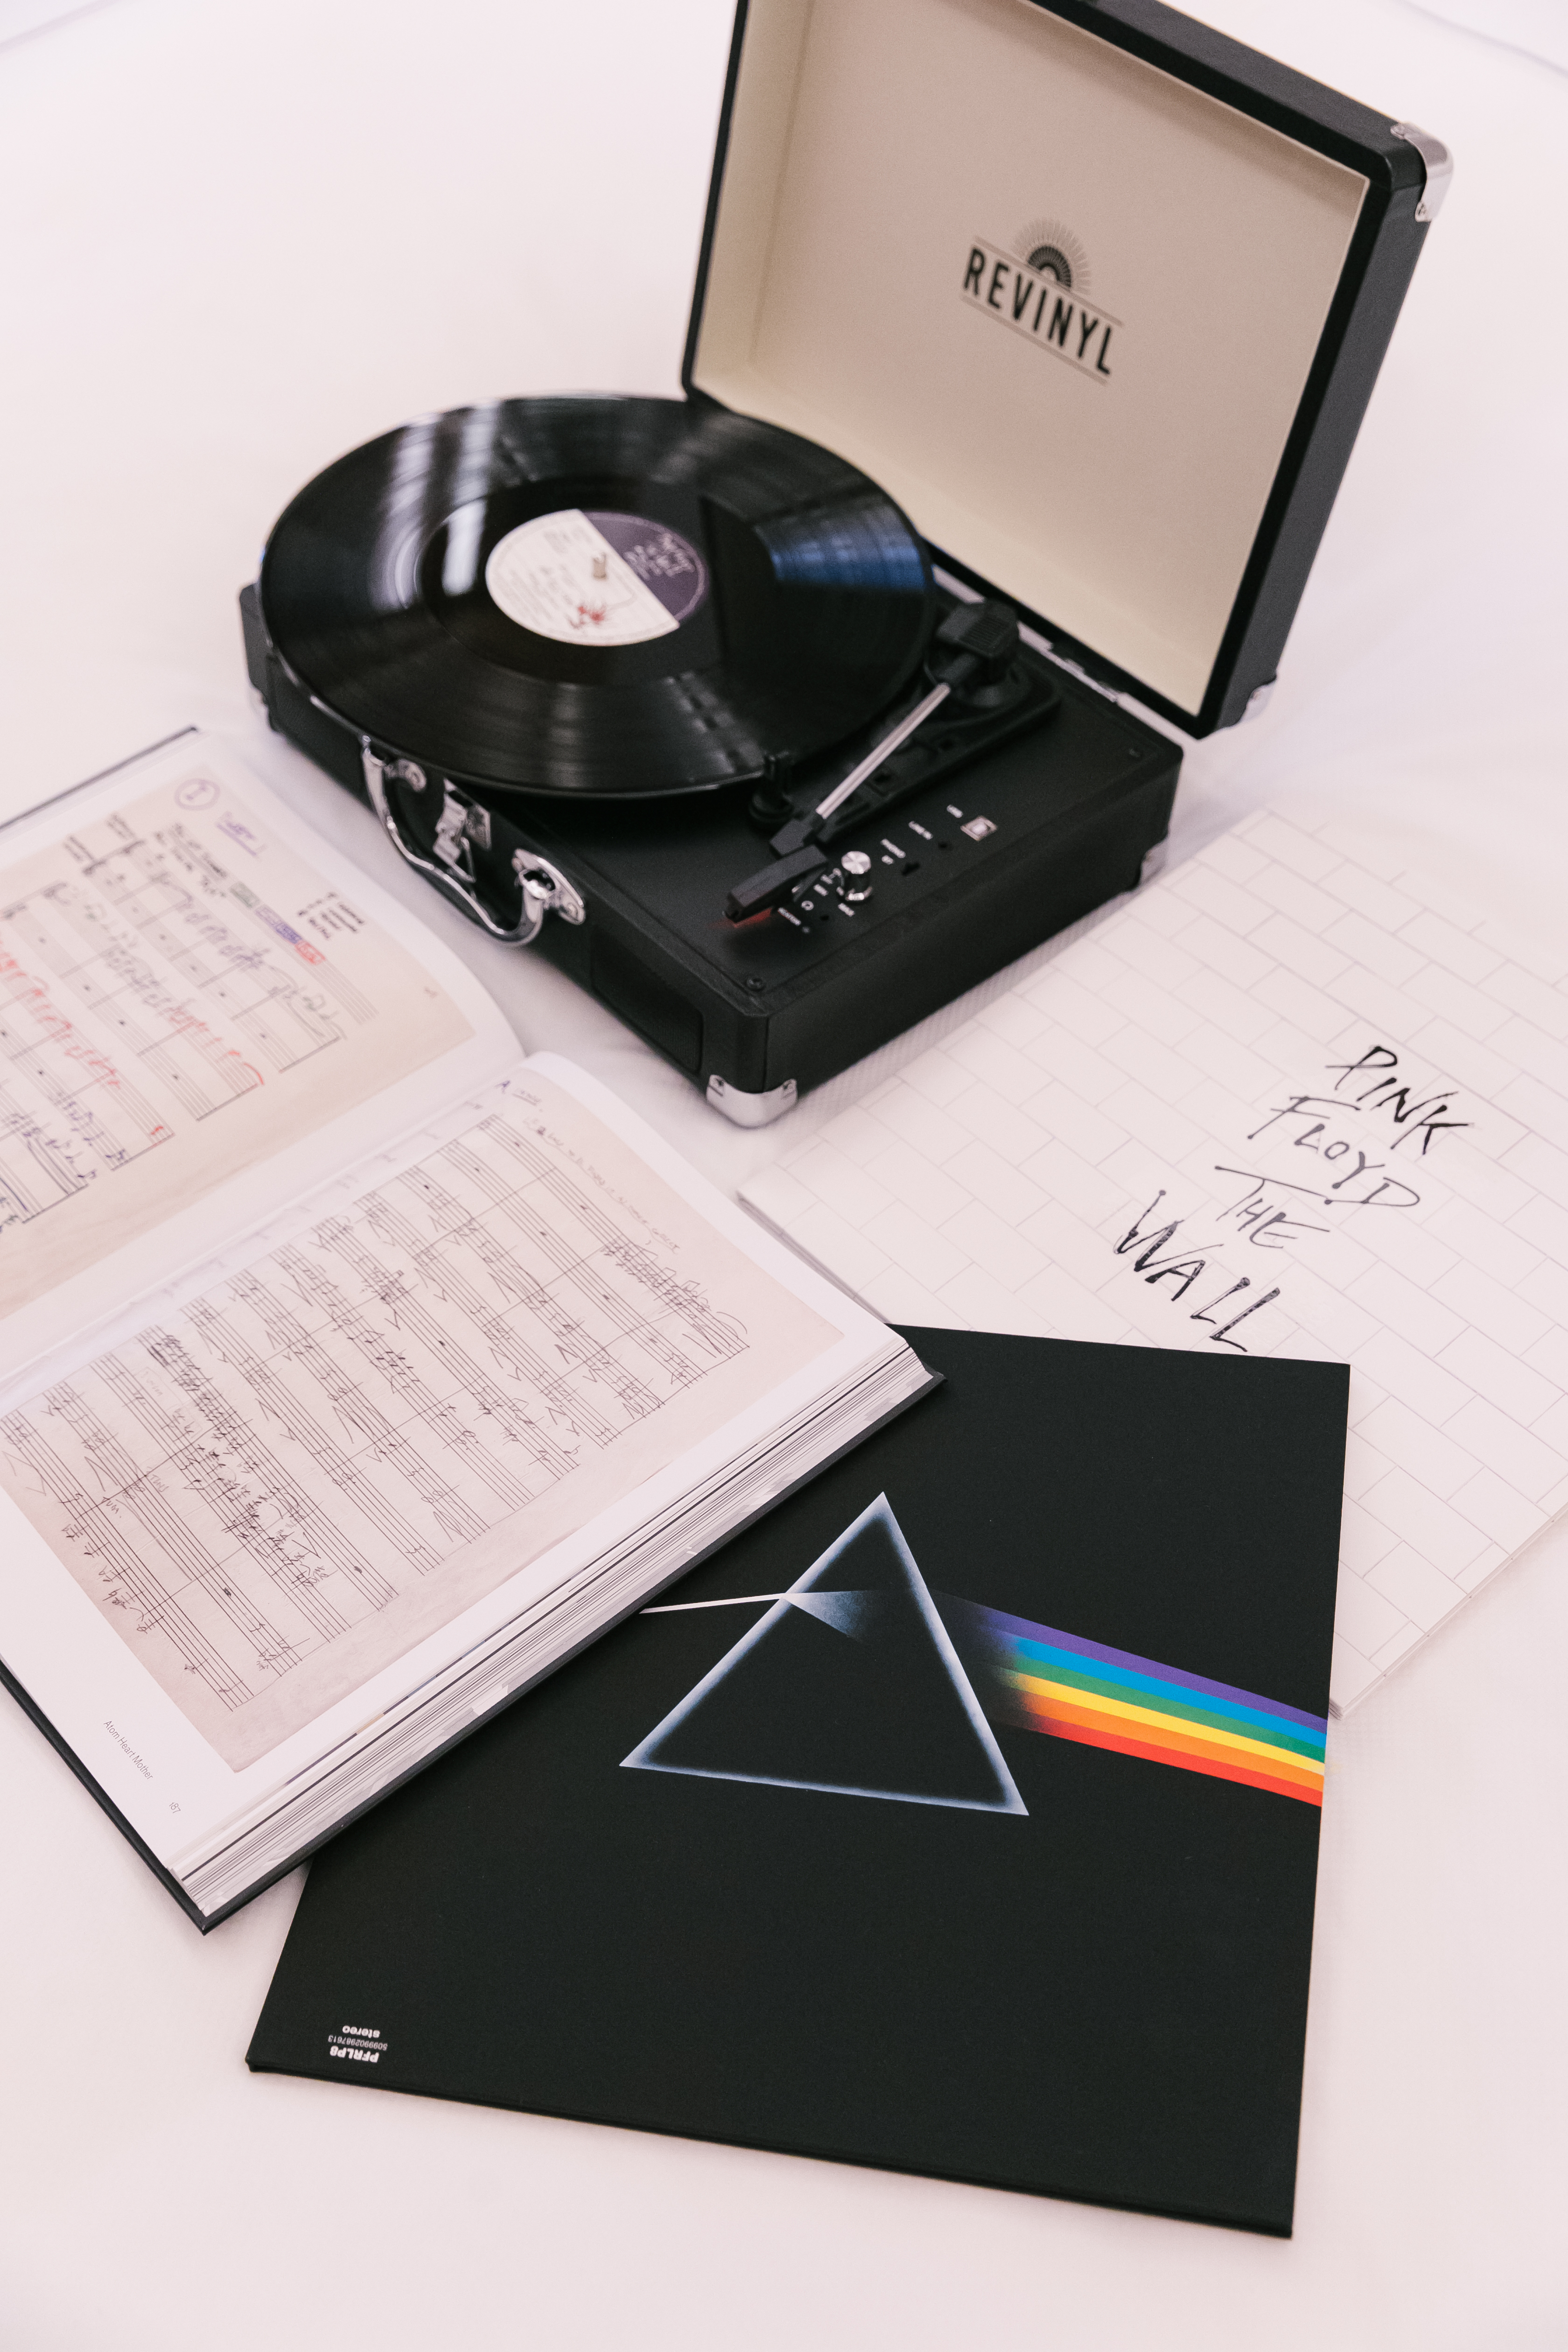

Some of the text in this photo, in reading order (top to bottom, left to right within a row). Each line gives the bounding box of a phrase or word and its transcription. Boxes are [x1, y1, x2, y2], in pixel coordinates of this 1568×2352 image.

[963, 245, 1111, 375] REVINYL
[1326, 1045, 1474, 1155] PINK
[1248, 1095, 1420, 1207] FLOYD
[1215, 1165, 1330, 1248] THE
[1113, 1190, 1281, 1352] WALL
[103, 1721, 153, 1779] Atom Heart Mother
[169, 1802, 181, 1813] 187
[328, 2035, 388, 2051] 5099902987613
[330, 2045, 379, 2063] PFRLP8
[342, 2025, 380, 2038] stereo
